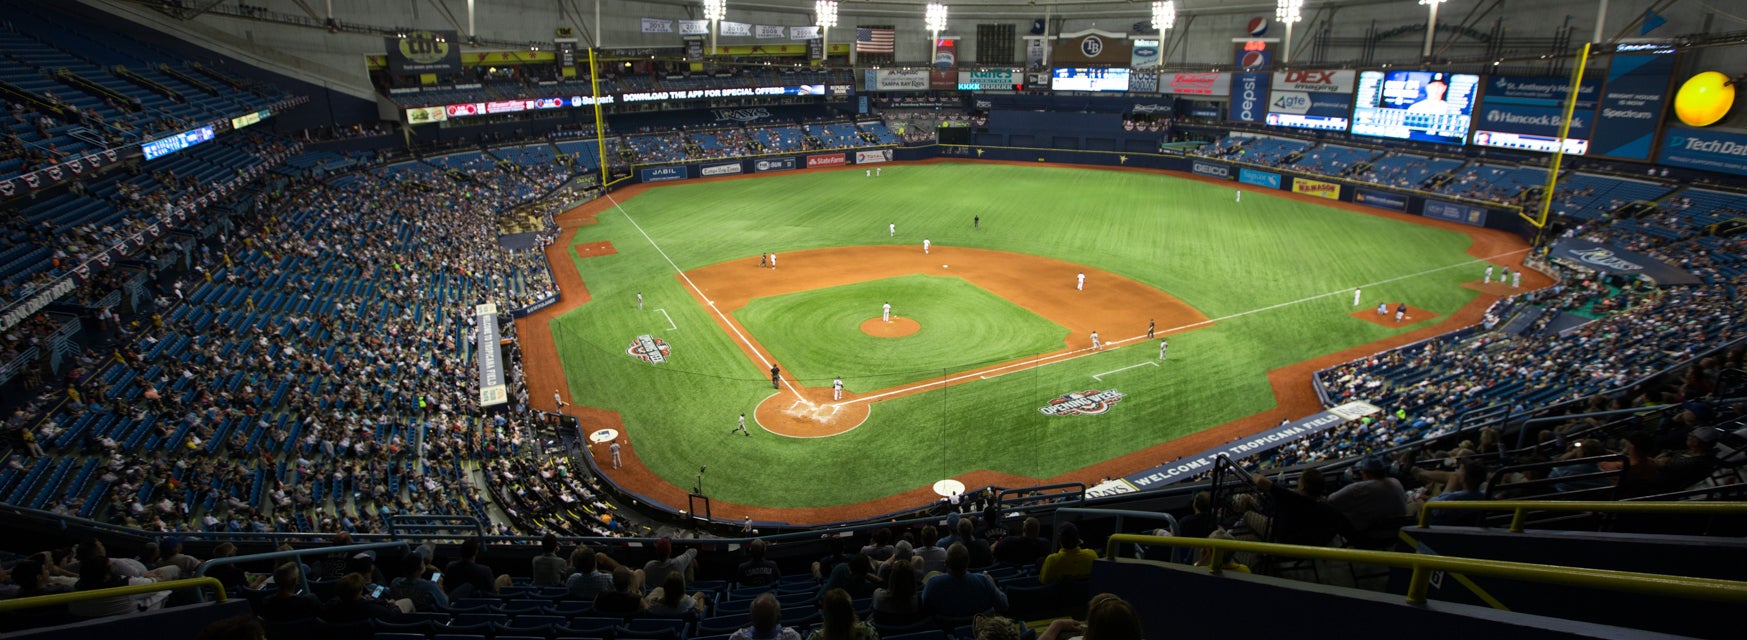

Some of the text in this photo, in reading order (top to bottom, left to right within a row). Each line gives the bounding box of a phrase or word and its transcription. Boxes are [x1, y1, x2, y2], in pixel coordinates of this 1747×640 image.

[1285, 71, 1336, 84] DEX
[1294, 82, 1339, 92] imaging
[1518, 83, 1557, 93] Anthony's
[623, 86, 785, 102] DOWNLOAD THE APP FOR SPECIAL OFFERS
[1241, 77, 1256, 122] pepsi
[1286, 95, 1306, 106] gte
[1501, 112, 1550, 125] Hancock
[1602, 108, 1652, 119] Spectrum
[1685, 137, 1722, 153] Tech
[652, 168, 677, 176] JABIL
[1193, 163, 1228, 176] GEICO
[484, 341, 496, 369] TROPICANA
[486, 369, 497, 386] FIELD
[1040, 388, 1121, 415] OPENING WEEK
[1134, 414, 1340, 487] WELCOME TO TROPICANA FIELD
